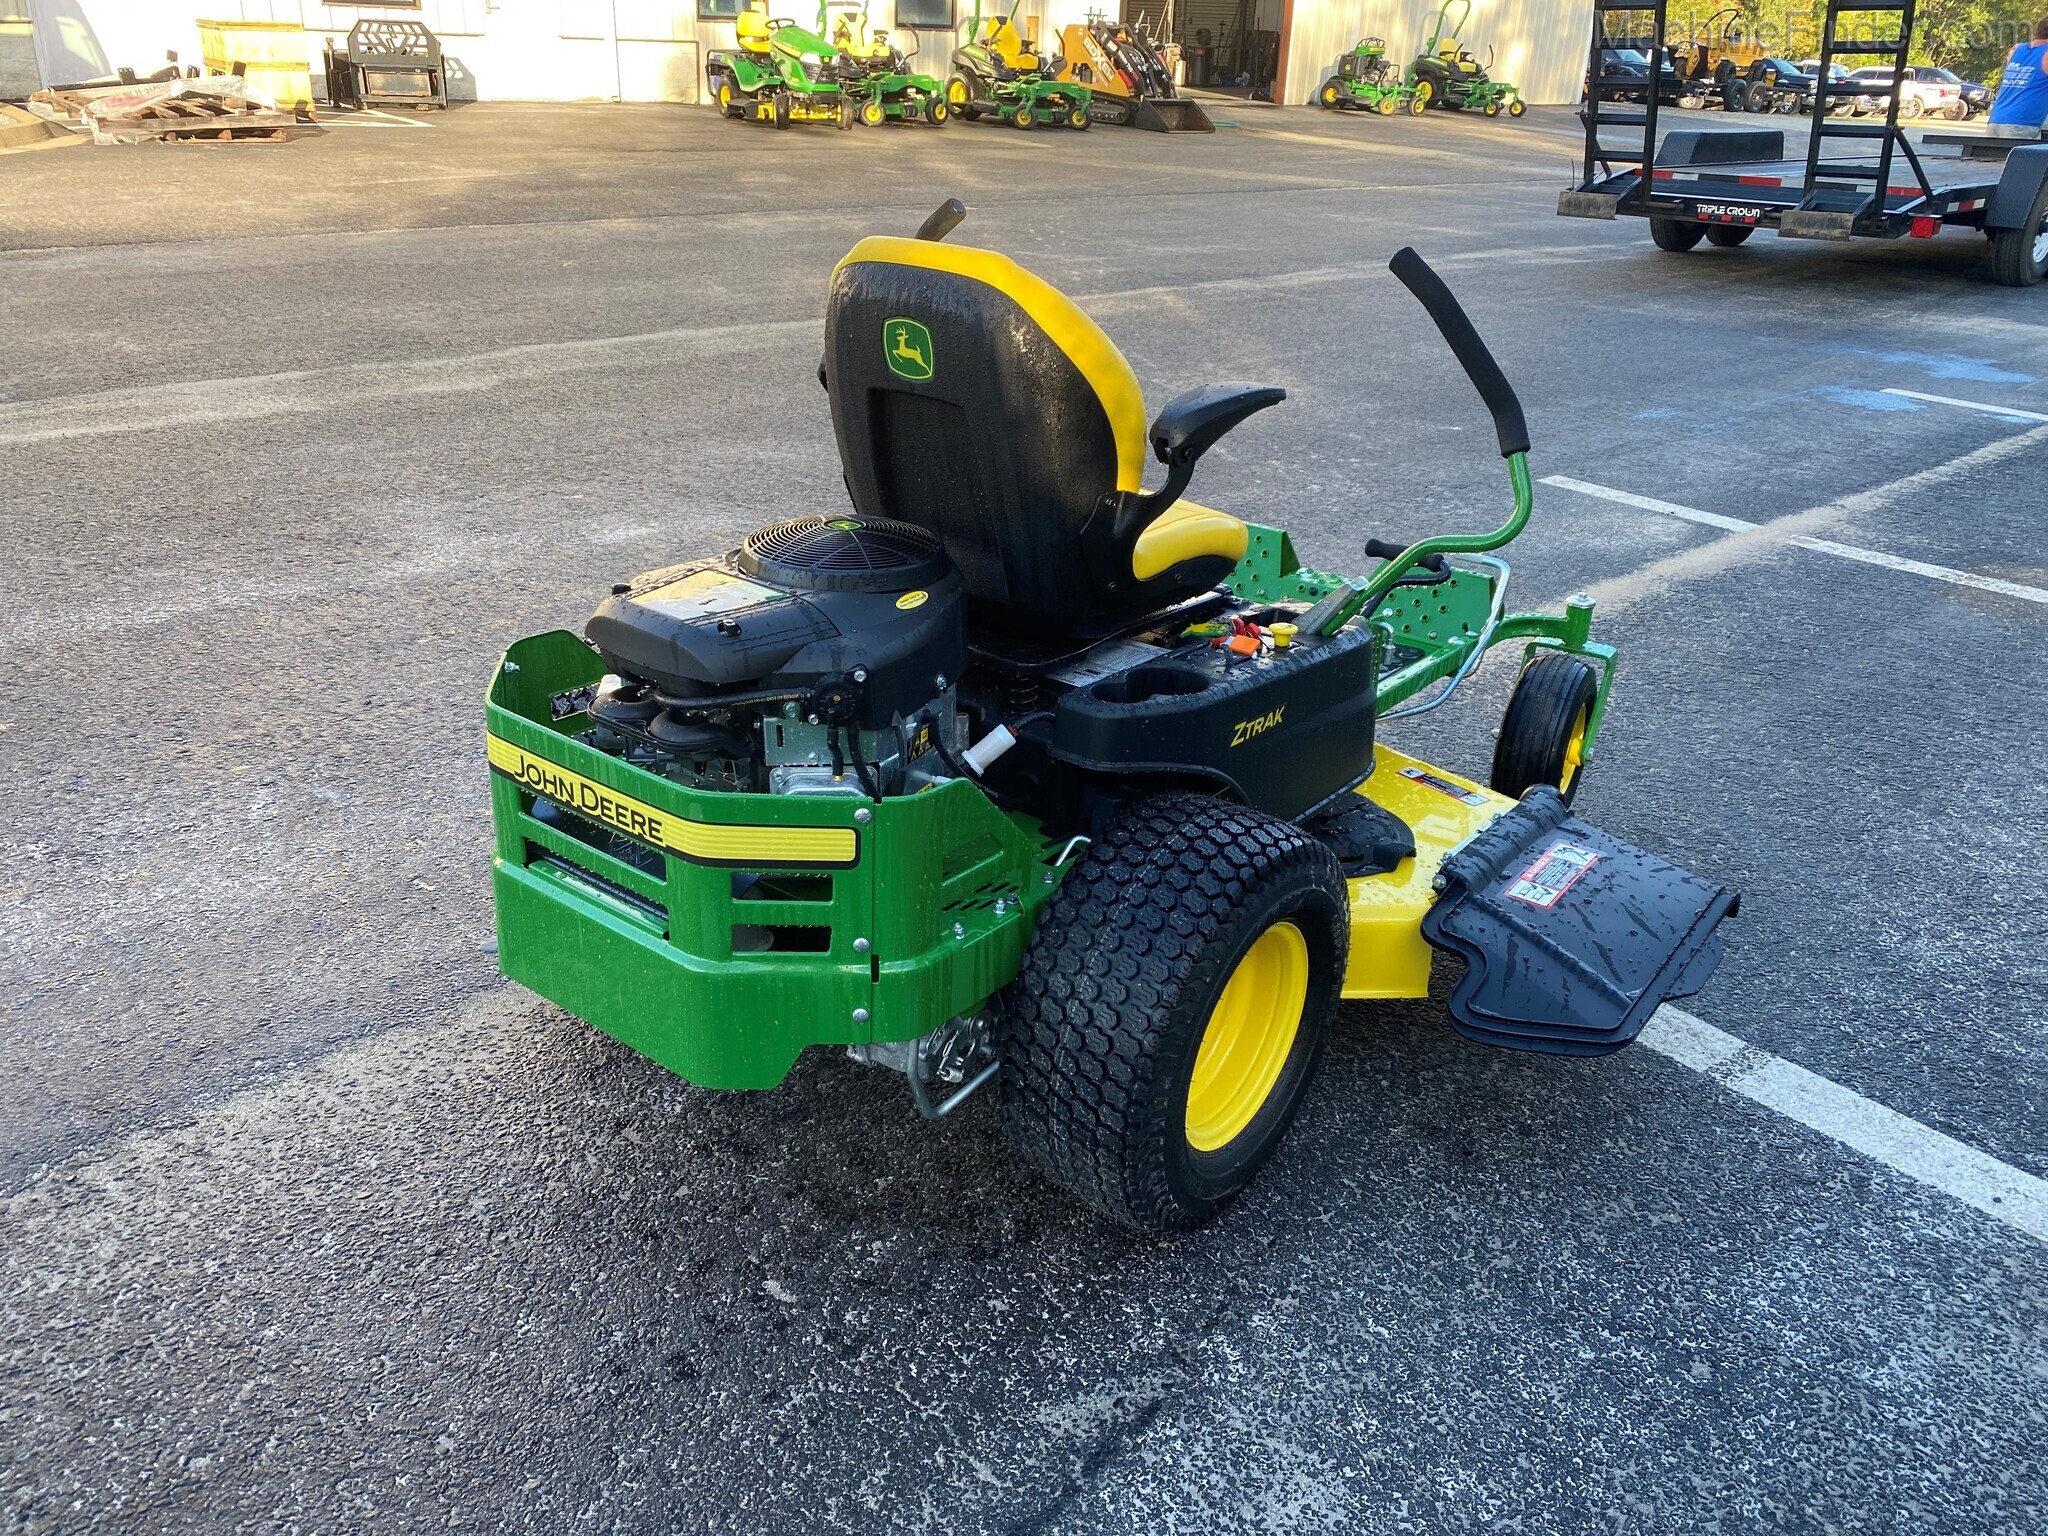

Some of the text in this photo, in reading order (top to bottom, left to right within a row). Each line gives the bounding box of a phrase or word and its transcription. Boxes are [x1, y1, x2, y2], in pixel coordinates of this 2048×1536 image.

[1696, 203, 1760, 218] TRIPLE CROWN
[1230, 705, 1286, 747] ZTRAK
[514, 754, 664, 843] JOHN DEERE
